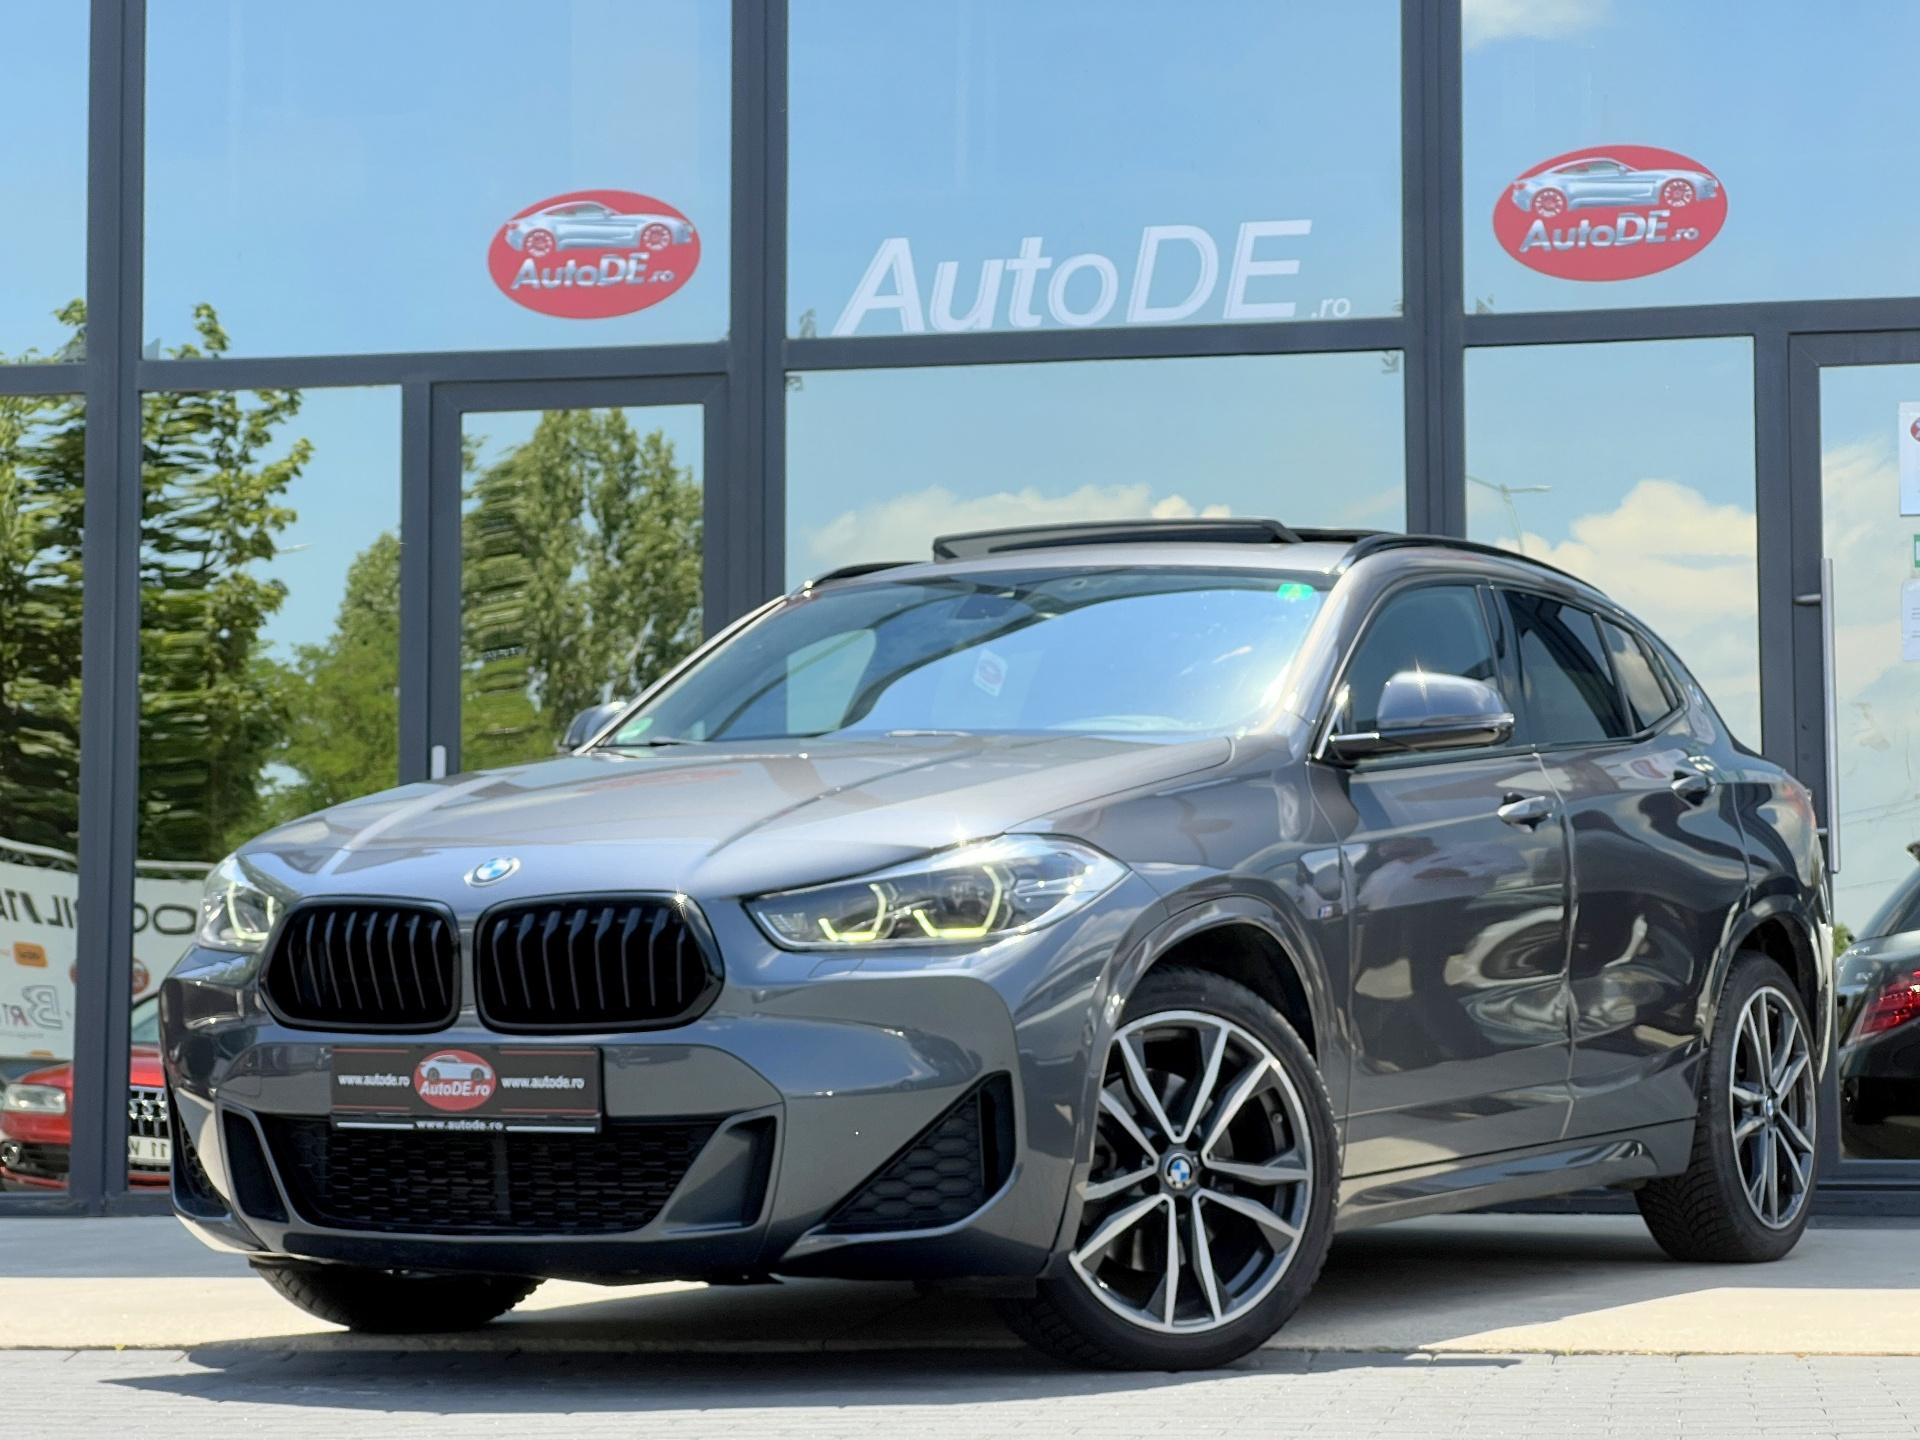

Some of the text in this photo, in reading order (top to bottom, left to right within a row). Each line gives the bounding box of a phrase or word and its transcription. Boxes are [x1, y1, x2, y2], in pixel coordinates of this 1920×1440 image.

[338, 1073, 411, 1088] www.autode.ro
[501, 1075, 585, 1090] www.autode.ro
[419, 1079, 490, 1098] AutoDE.ro
[416, 1119, 503, 1132] www.autode.ro
